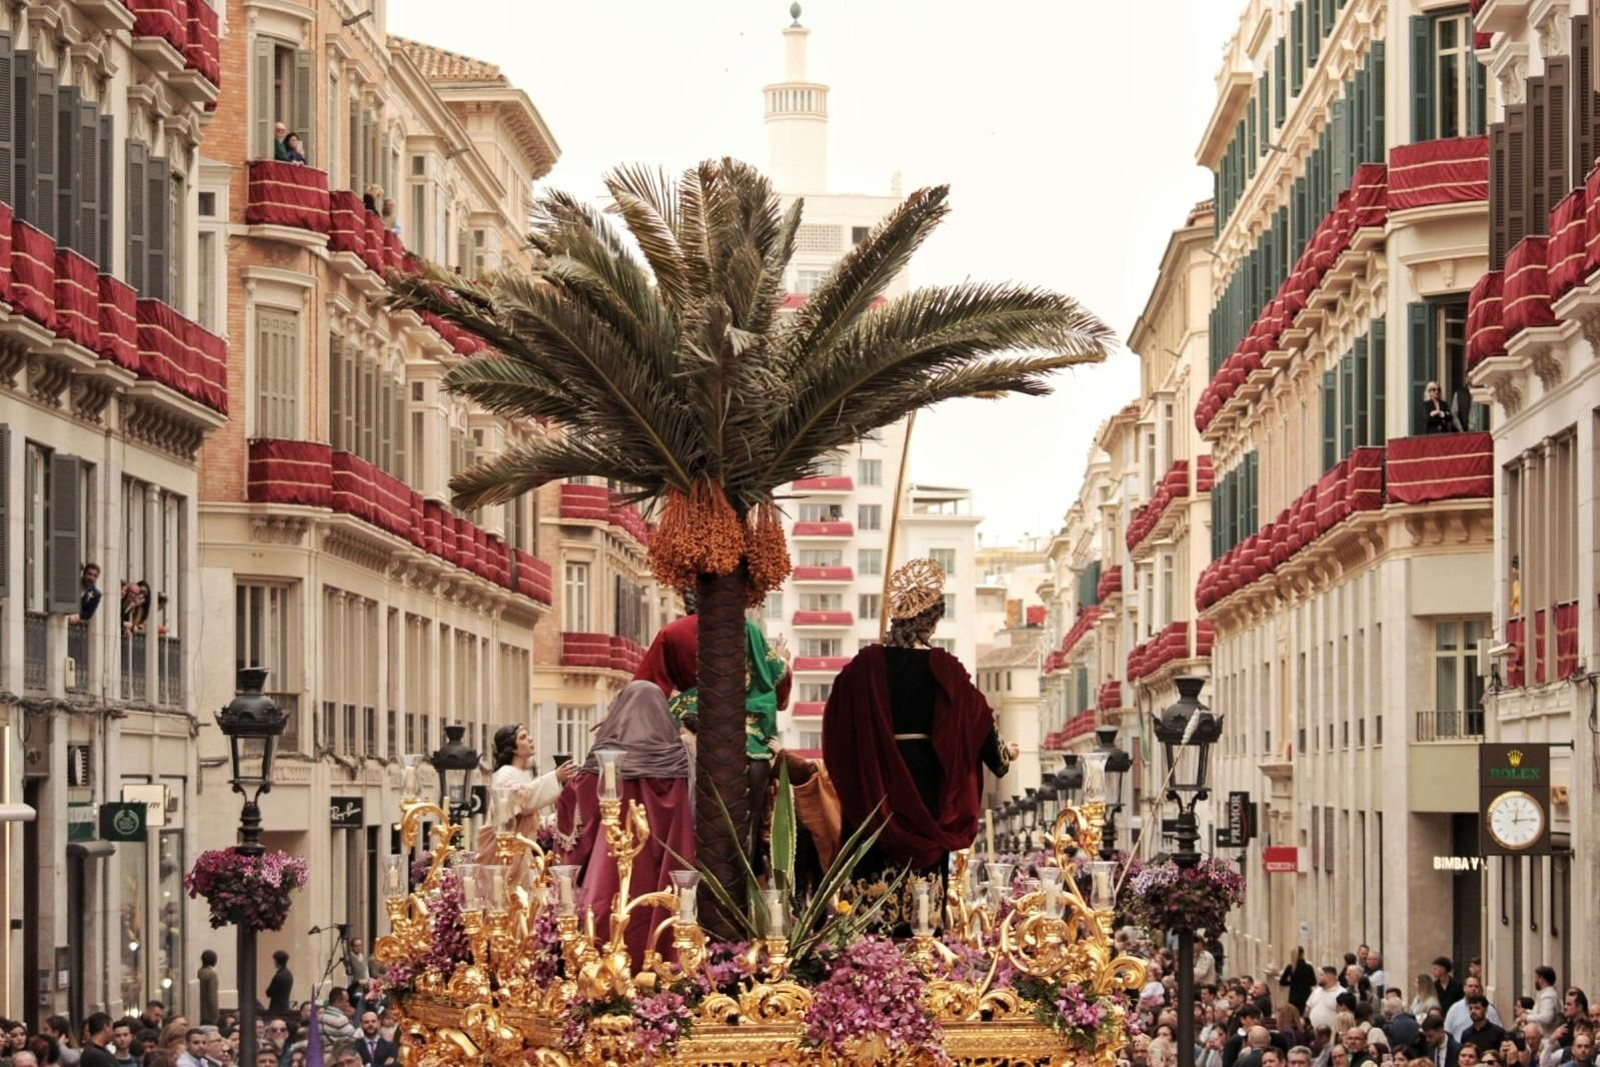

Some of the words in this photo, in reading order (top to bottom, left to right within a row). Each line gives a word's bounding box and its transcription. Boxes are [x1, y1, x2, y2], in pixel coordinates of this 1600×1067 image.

[1489, 768, 1540, 779] ROLEX
[1231, 794, 1241, 844] PRIMOR
[1433, 856, 1469, 870] BIMBA
[1470, 857, 1479, 870] Y
